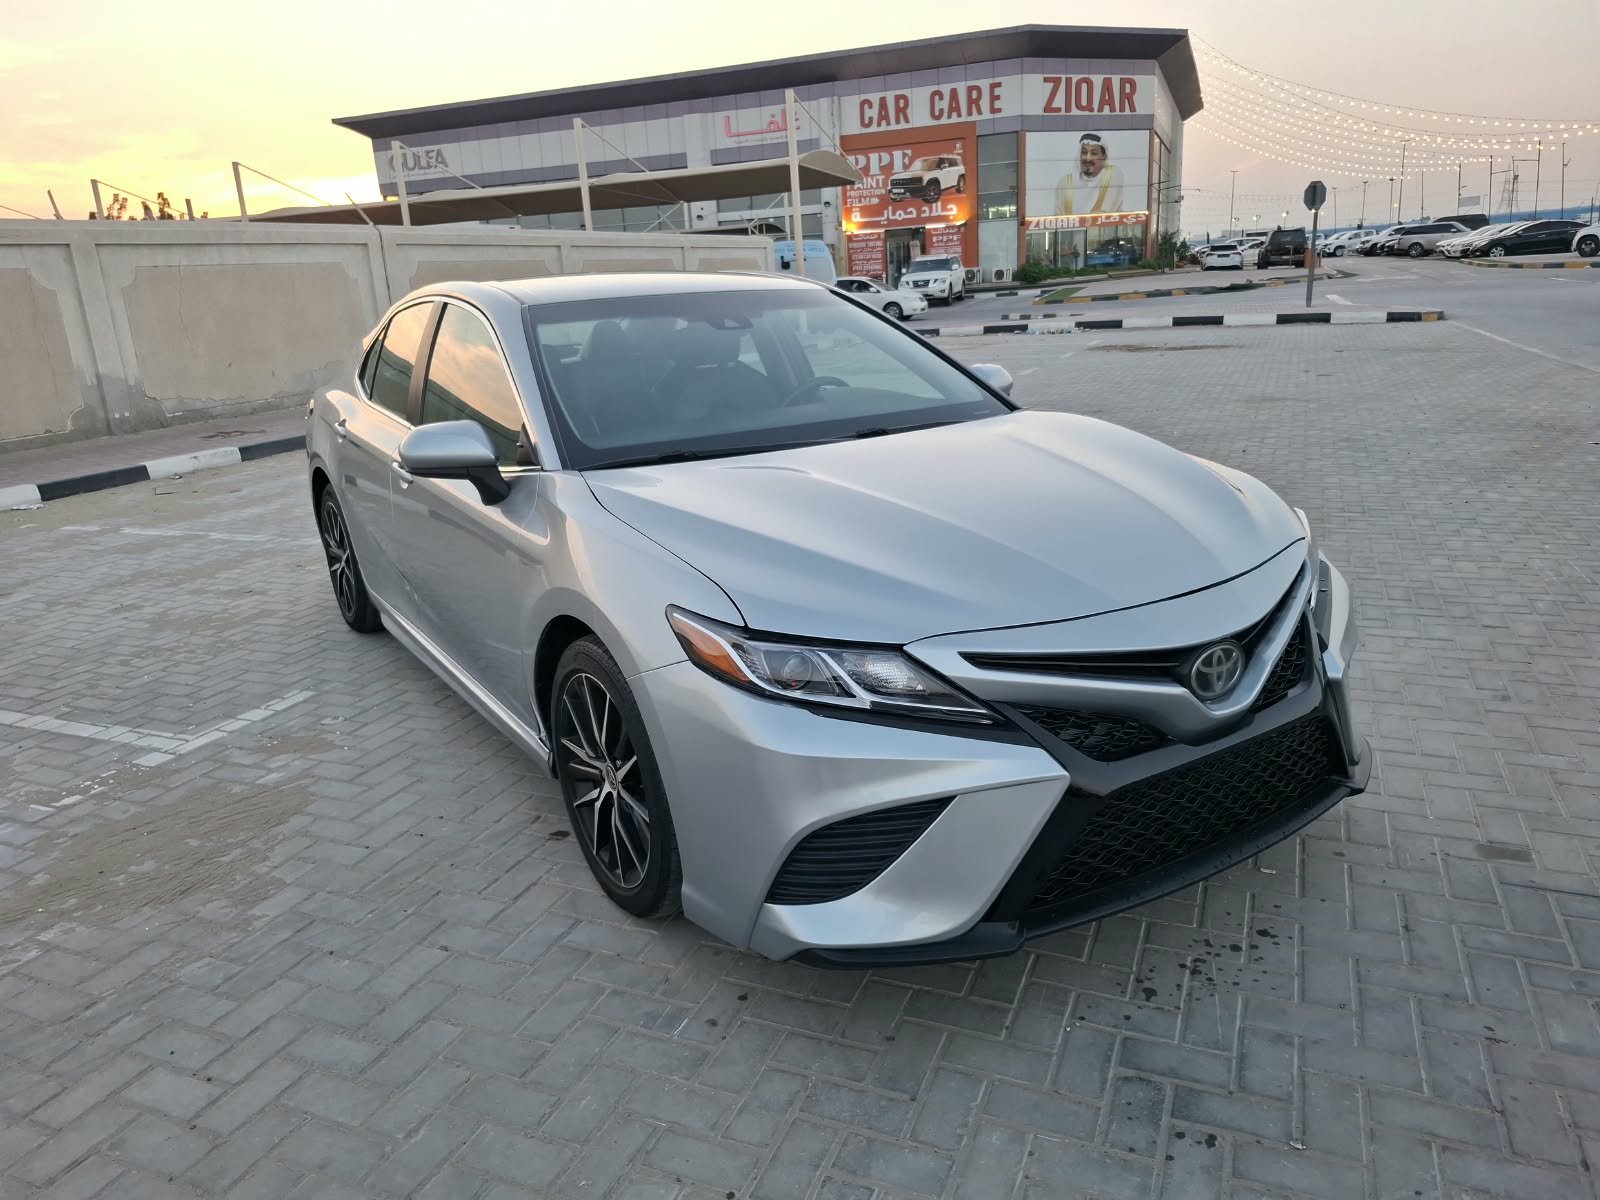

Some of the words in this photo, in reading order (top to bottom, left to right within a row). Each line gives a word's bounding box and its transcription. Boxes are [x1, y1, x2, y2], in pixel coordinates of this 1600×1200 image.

[1043, 76, 1137, 113] ZIQAR
[859, 93, 910, 128] CAR
[929, 82, 1003, 121] CARE
[847, 149, 913, 176] PPF
[847, 188, 886, 198] PROTECTION
[847, 197, 870, 207] FILM
[1028, 217, 1080, 230] ZIQAR
[932, 234, 962, 243] PPF
